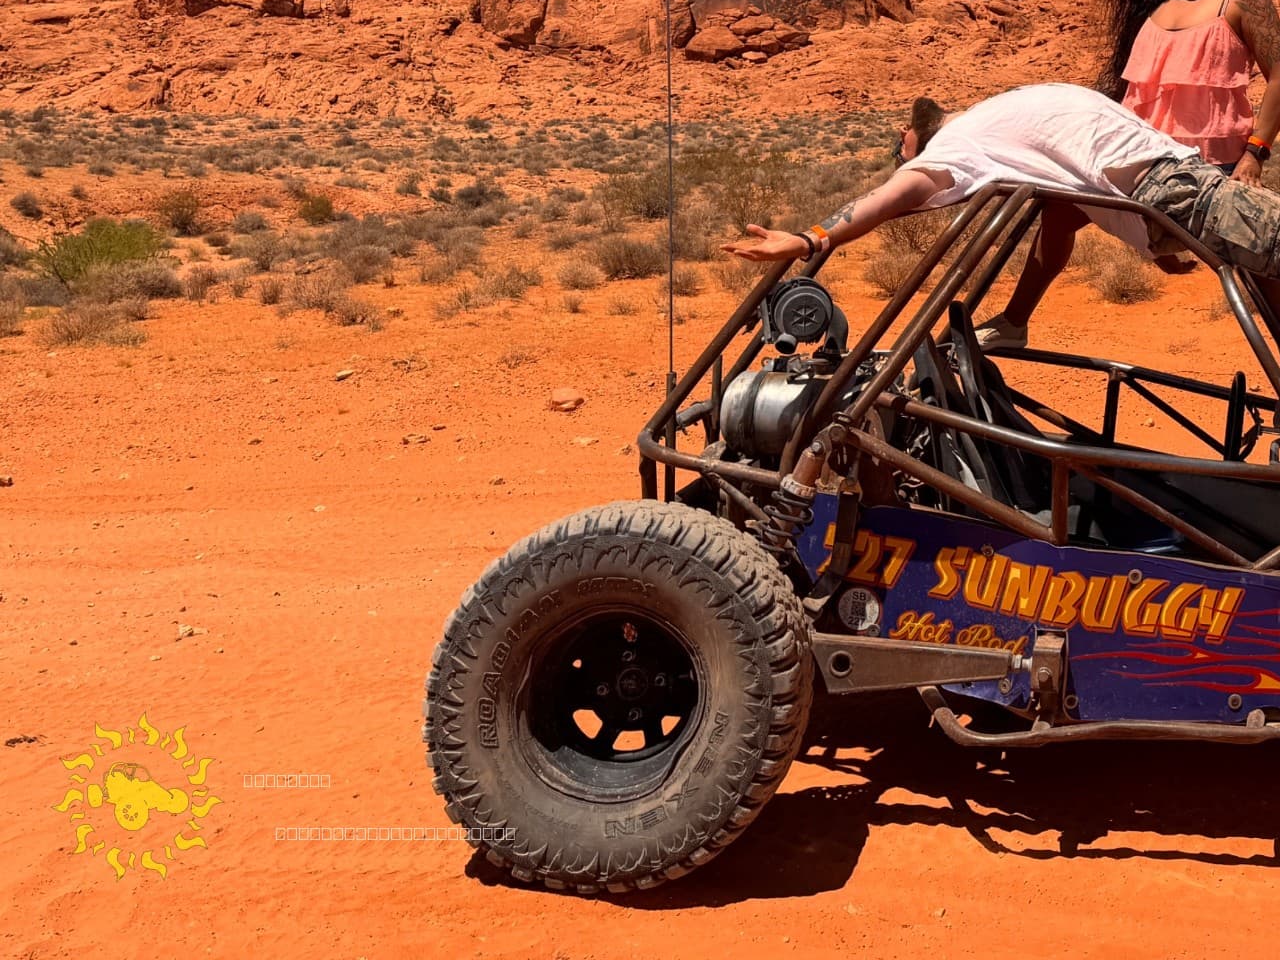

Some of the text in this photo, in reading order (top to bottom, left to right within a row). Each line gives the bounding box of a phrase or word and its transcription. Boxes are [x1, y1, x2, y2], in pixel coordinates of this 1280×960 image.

[851, 591, 867, 601] SB
[927, 545, 1246, 644] SUNBUGGY
[889, 609, 953, 645] Hot
